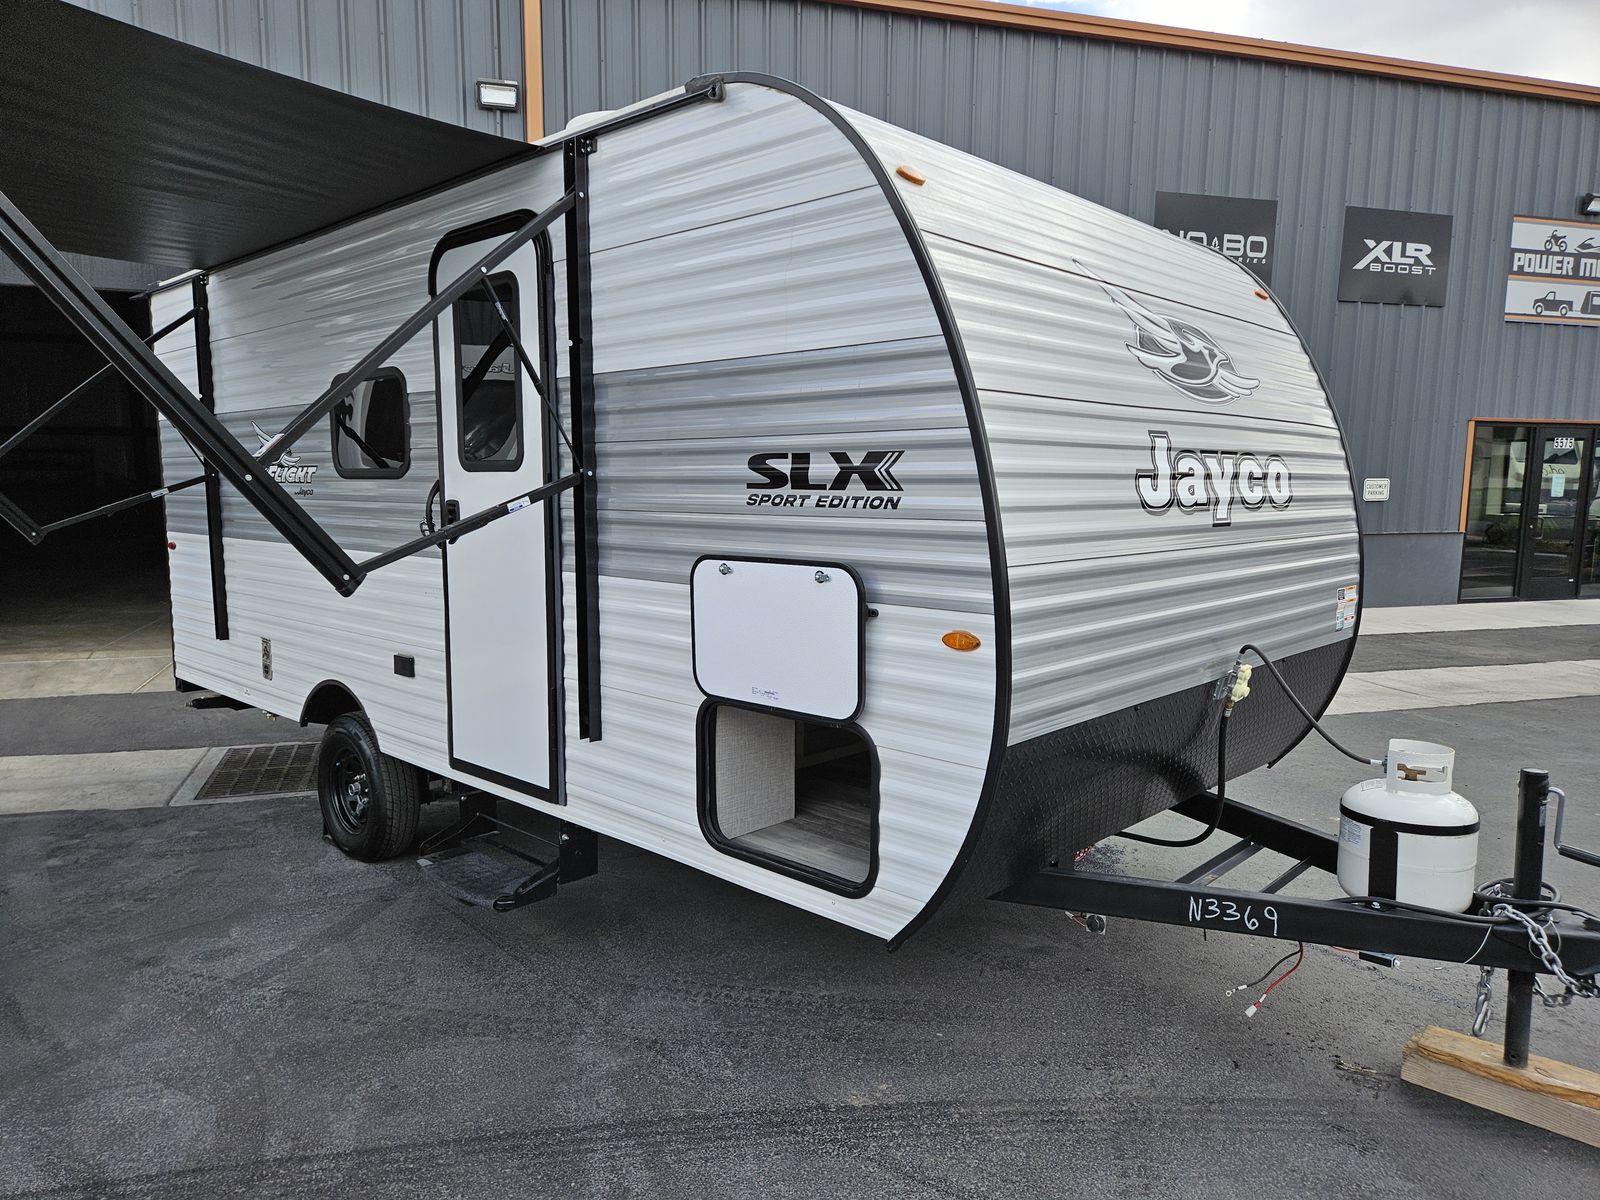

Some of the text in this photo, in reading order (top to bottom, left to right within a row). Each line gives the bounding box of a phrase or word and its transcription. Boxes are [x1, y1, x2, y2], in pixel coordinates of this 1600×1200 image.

[1353, 239, 1433, 269] XLR
[1513, 252, 1600, 279] POWER M
[1370, 263, 1436, 275] BOOST
[1555, 437, 1574, 448] 5575
[746, 450, 905, 491] SLX
[1135, 430, 1292, 527] Jayco
[746, 494, 902, 510] SPORT EDITION
[1188, 896, 1278, 936] N3369
